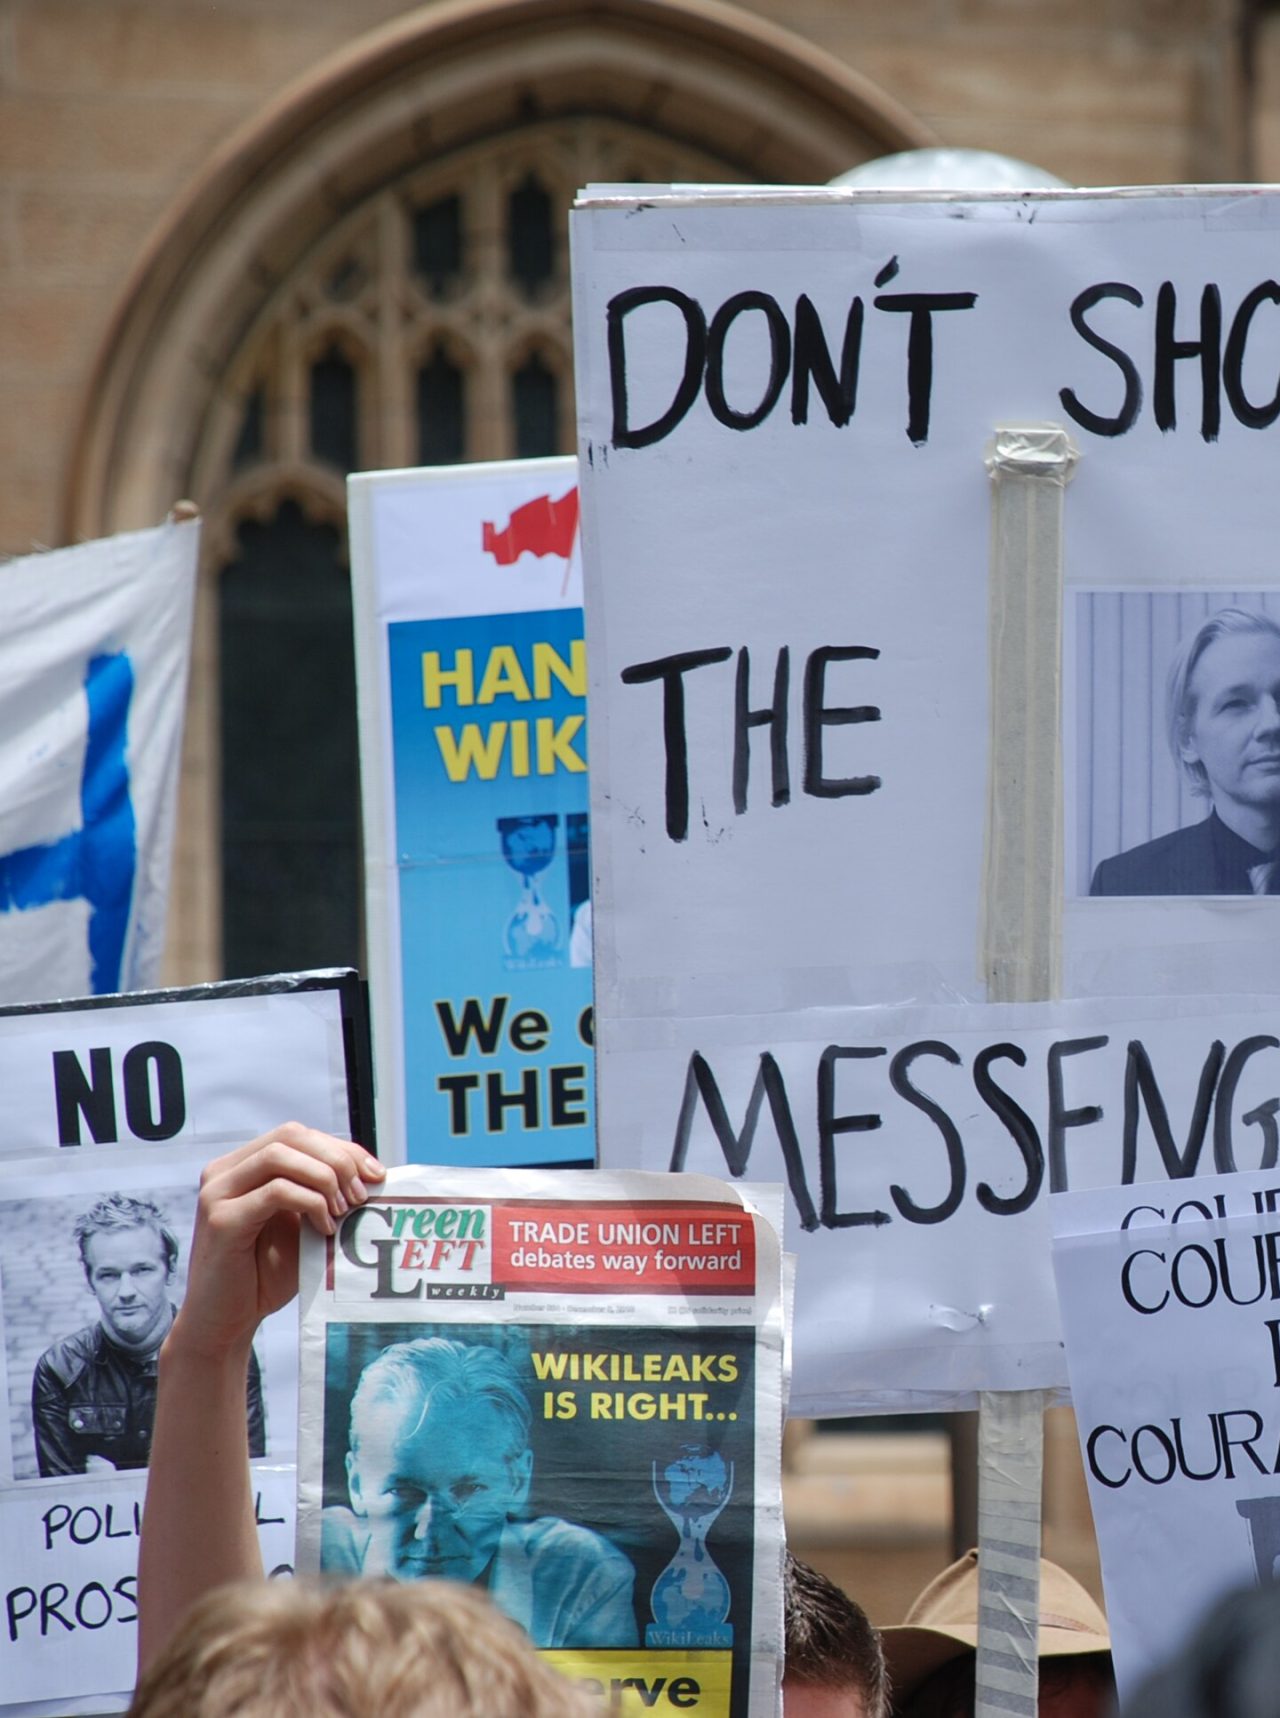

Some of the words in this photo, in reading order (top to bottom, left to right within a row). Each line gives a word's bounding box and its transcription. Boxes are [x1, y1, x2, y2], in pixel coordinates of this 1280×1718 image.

[607, 255, 979, 449] DON'T
[421, 640, 586, 709] HAN
[434, 715, 587, 782] WIK
[621, 645, 882, 843] THE
[436, 997, 549, 1057] We
[53, 1041, 186, 1147] NO
[340, 1206, 487, 1269] Green
[509, 1221, 589, 1245] TRADE
[598, 1223, 679, 1245] UNION
[688, 1223, 741, 1245] LEFT
[510, 1248, 595, 1270] debates
[602, 1255, 648, 1275] way
[654, 1249, 741, 1270] forward
[431, 1286, 500, 1299] weekly
[531, 1353, 738, 1382] WIKILEAKS
[544, 1392, 577, 1420] IS
[591, 1392, 738, 1421] RIGHT...
[42, 1491, 285, 1550] POLIL
[650, 1631, 730, 1646] WikiLeaks
[576, 1677, 701, 1709] erve
